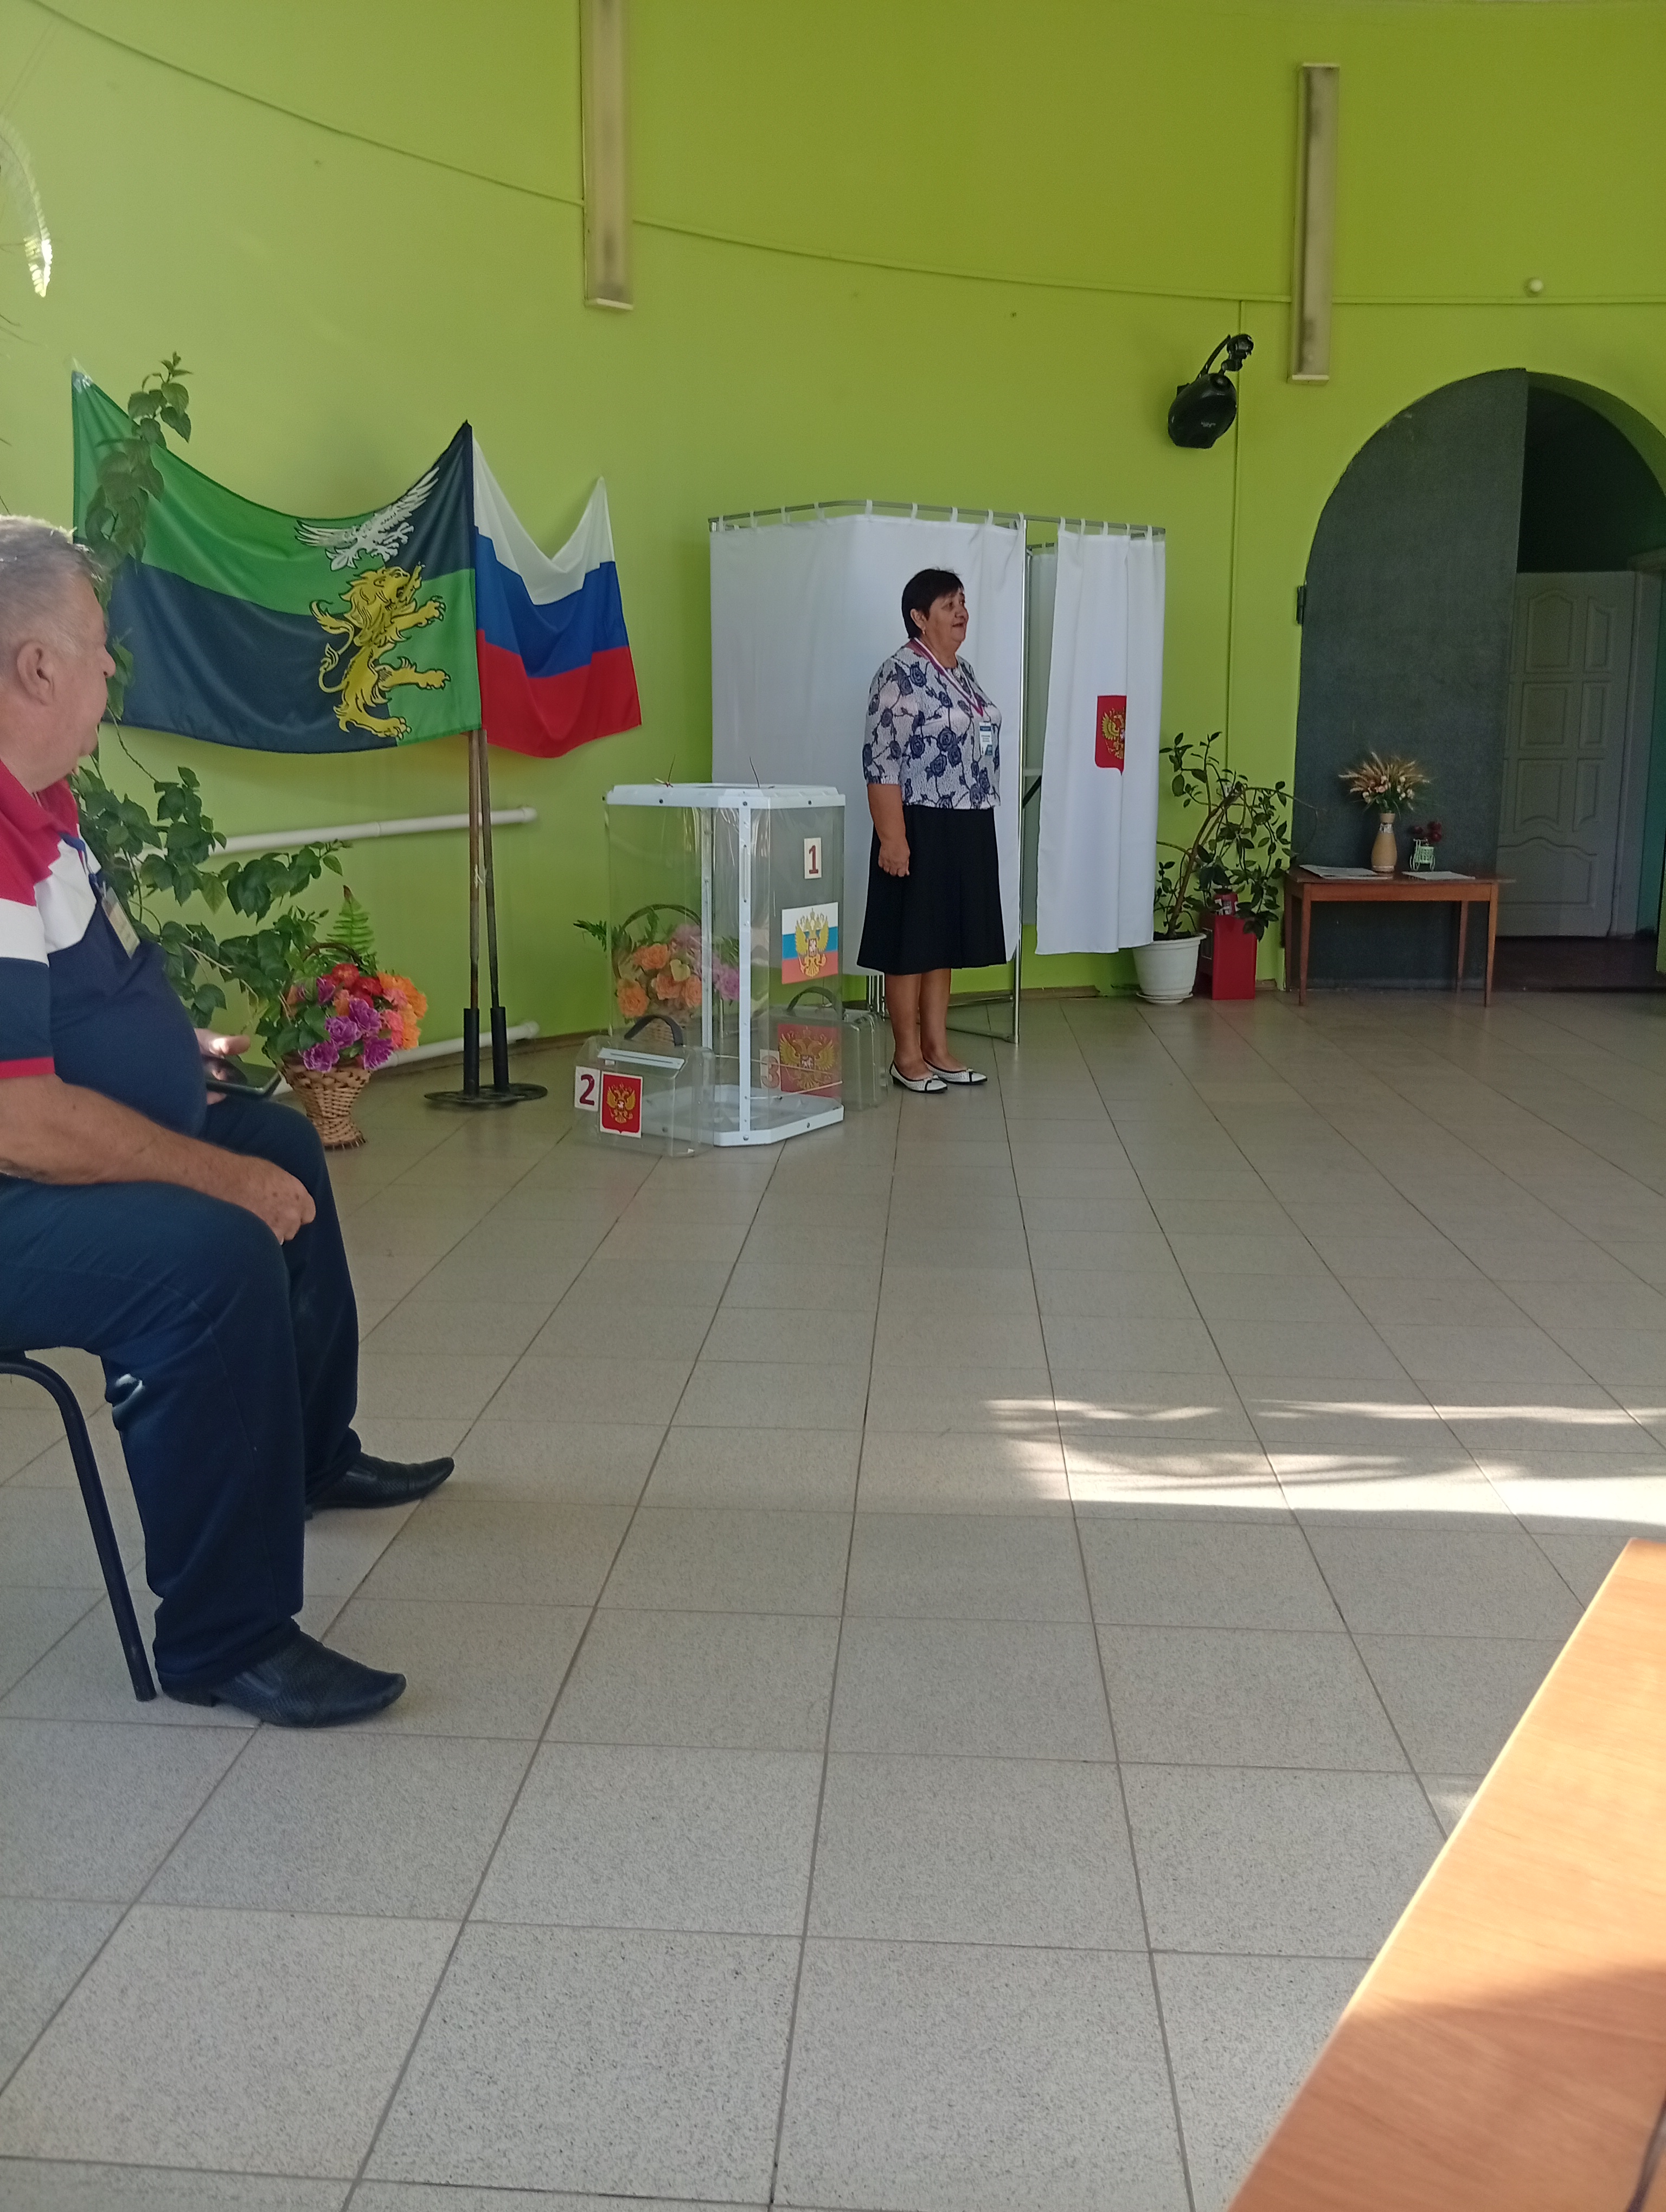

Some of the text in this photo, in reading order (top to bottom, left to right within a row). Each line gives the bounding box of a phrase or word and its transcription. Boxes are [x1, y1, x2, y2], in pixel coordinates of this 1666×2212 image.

[809, 845, 819, 874] 1
[761, 1056, 780, 1089] 3
[580, 1074, 595, 1105] 2
